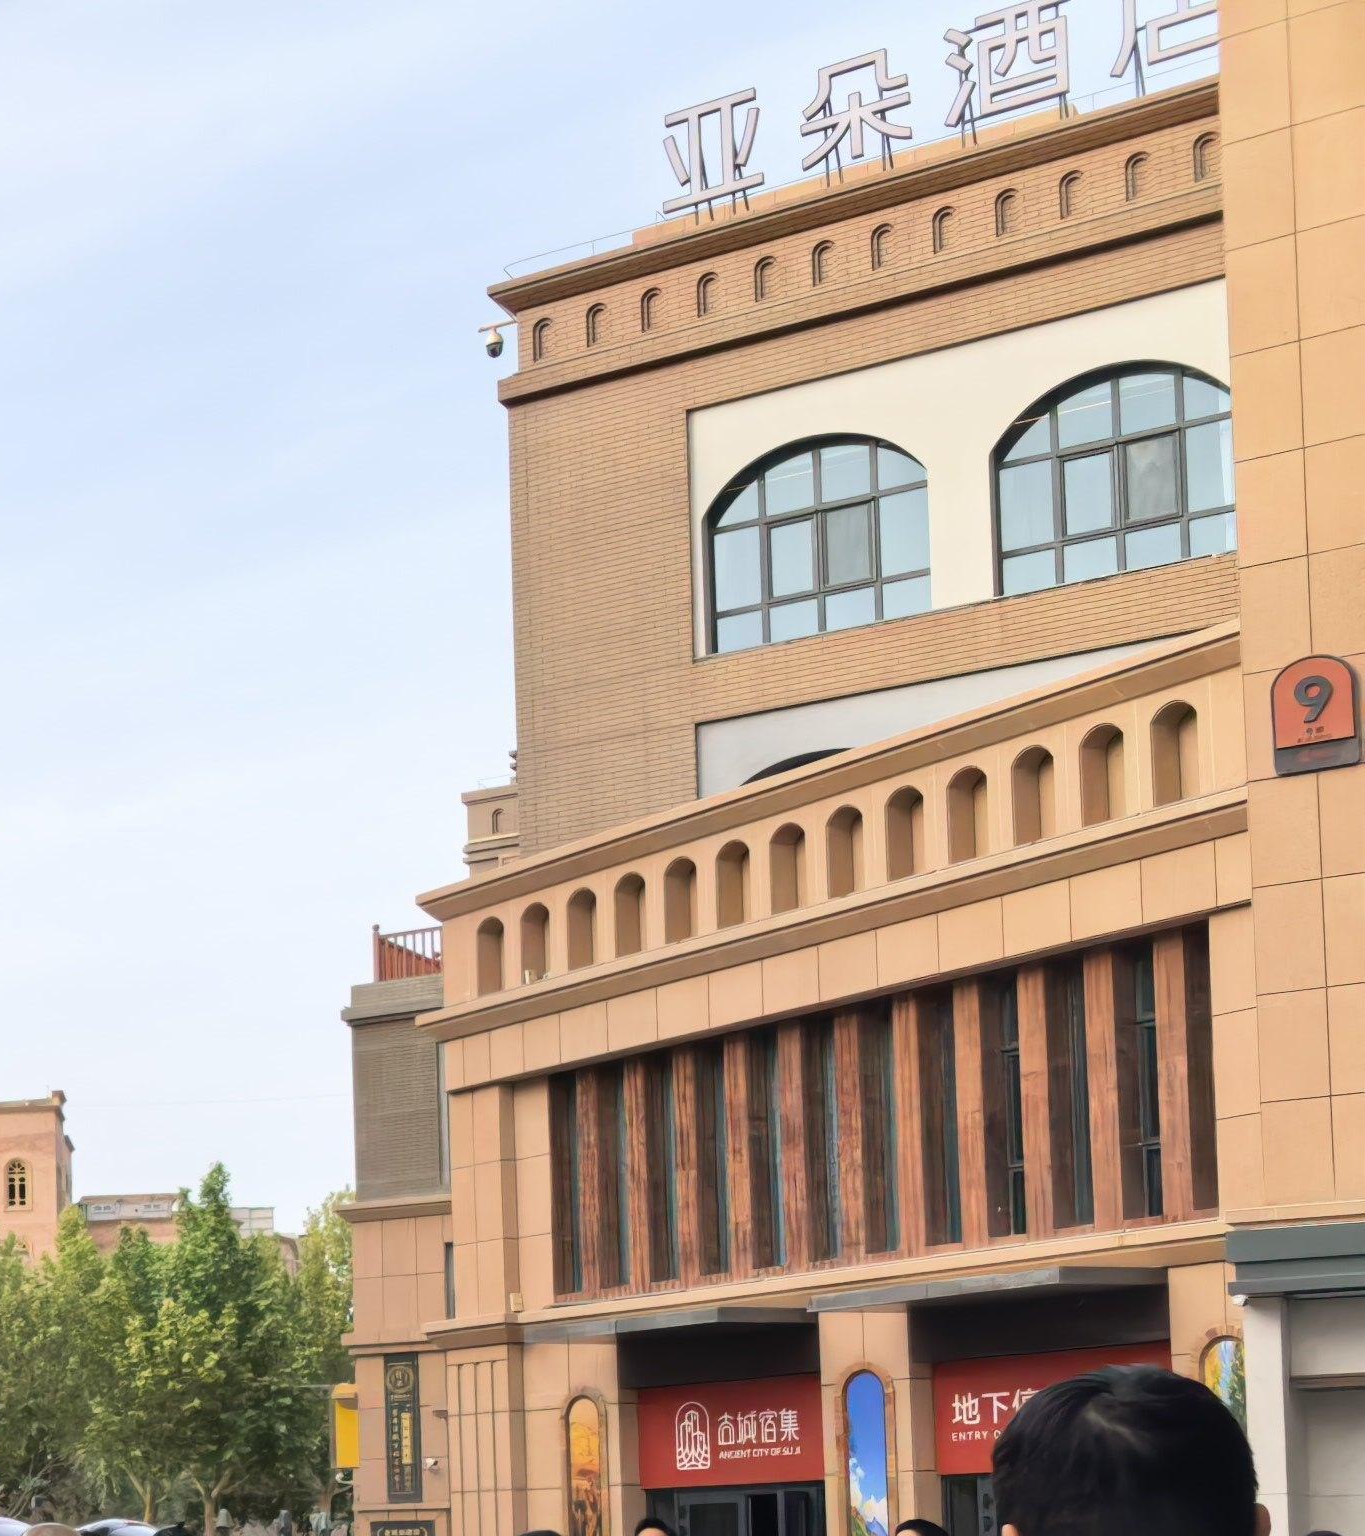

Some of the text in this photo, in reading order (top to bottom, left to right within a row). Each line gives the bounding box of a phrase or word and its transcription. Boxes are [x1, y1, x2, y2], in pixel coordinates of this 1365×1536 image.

[1294, 676, 1333, 724] 9
[717, 1407, 800, 1446] 古城宿集
[951, 1430, 989, 1442] ENTRY
[752, 1447, 770, 1457] CITY
[770, 1446, 781, 1456] OF
